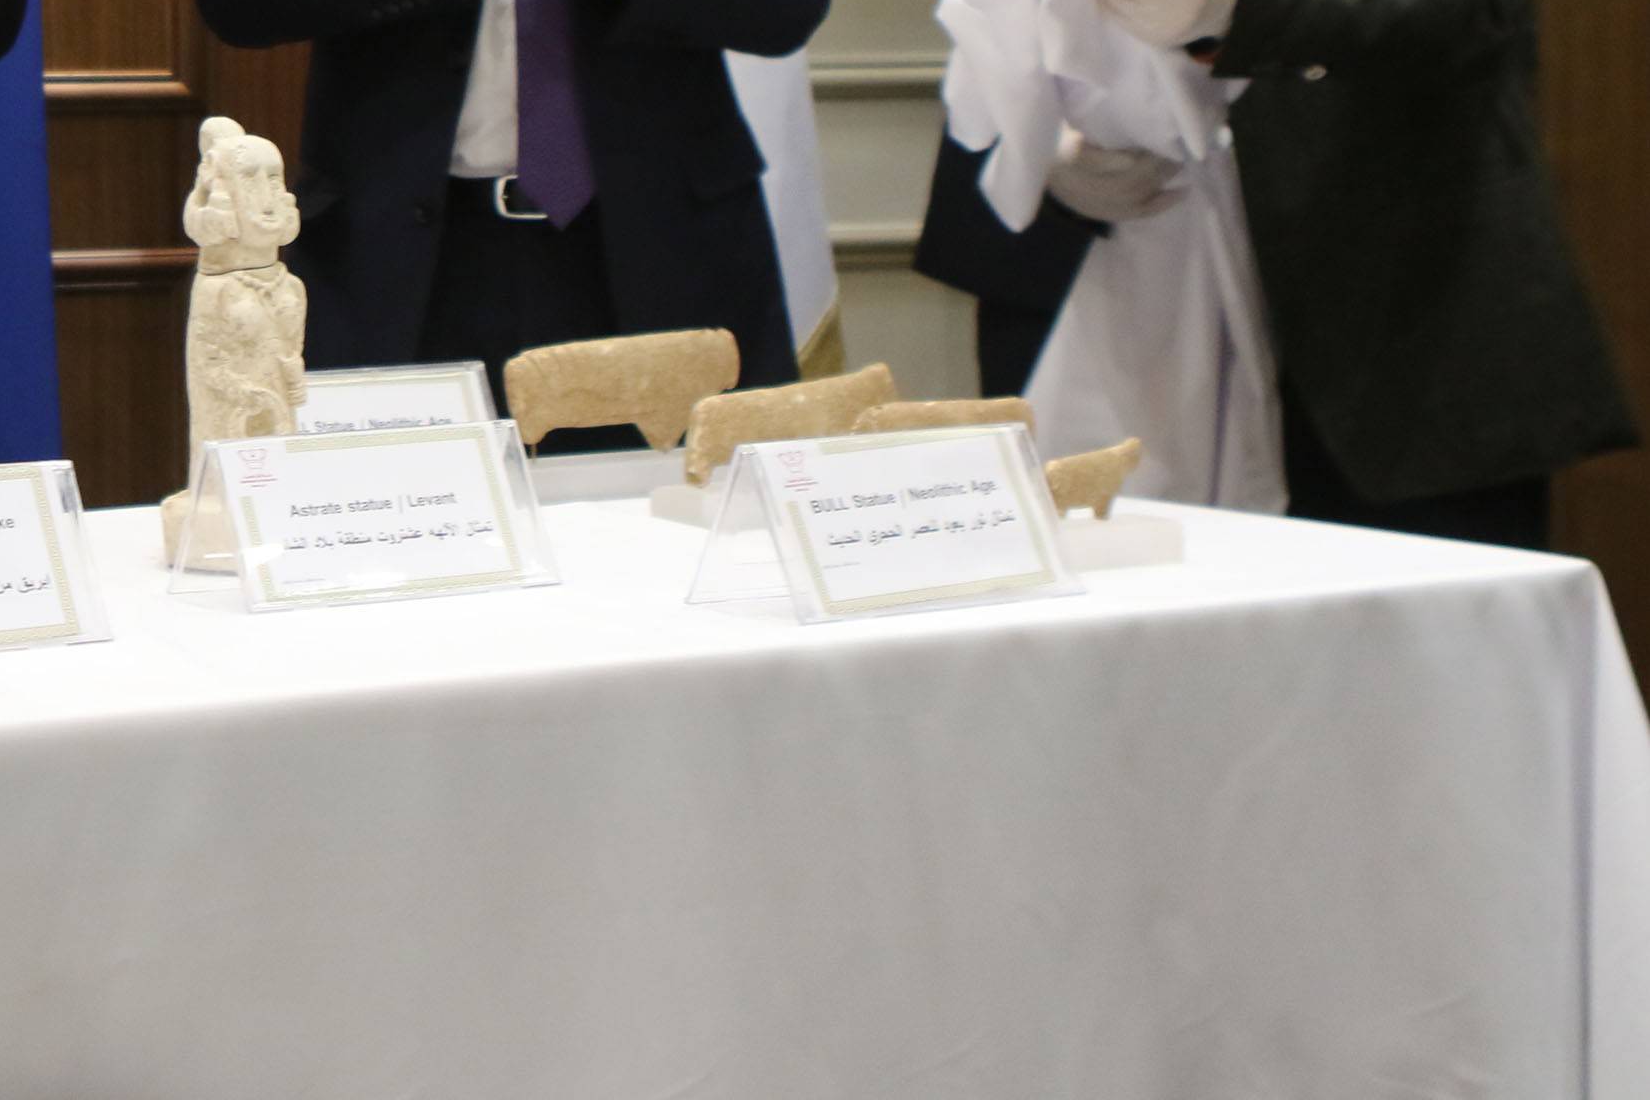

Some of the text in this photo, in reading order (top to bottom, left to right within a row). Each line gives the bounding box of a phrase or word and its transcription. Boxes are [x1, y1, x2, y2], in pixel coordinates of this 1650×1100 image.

[289, 502, 343, 518] Astrate
[347, 498, 393, 514] statue
[406, 492, 458, 508] Levant
[810, 495, 850, 514] BULL
[852, 492, 897, 509] Statue
[907, 482, 967, 502] Neolithic
[970, 478, 998, 496] Age
